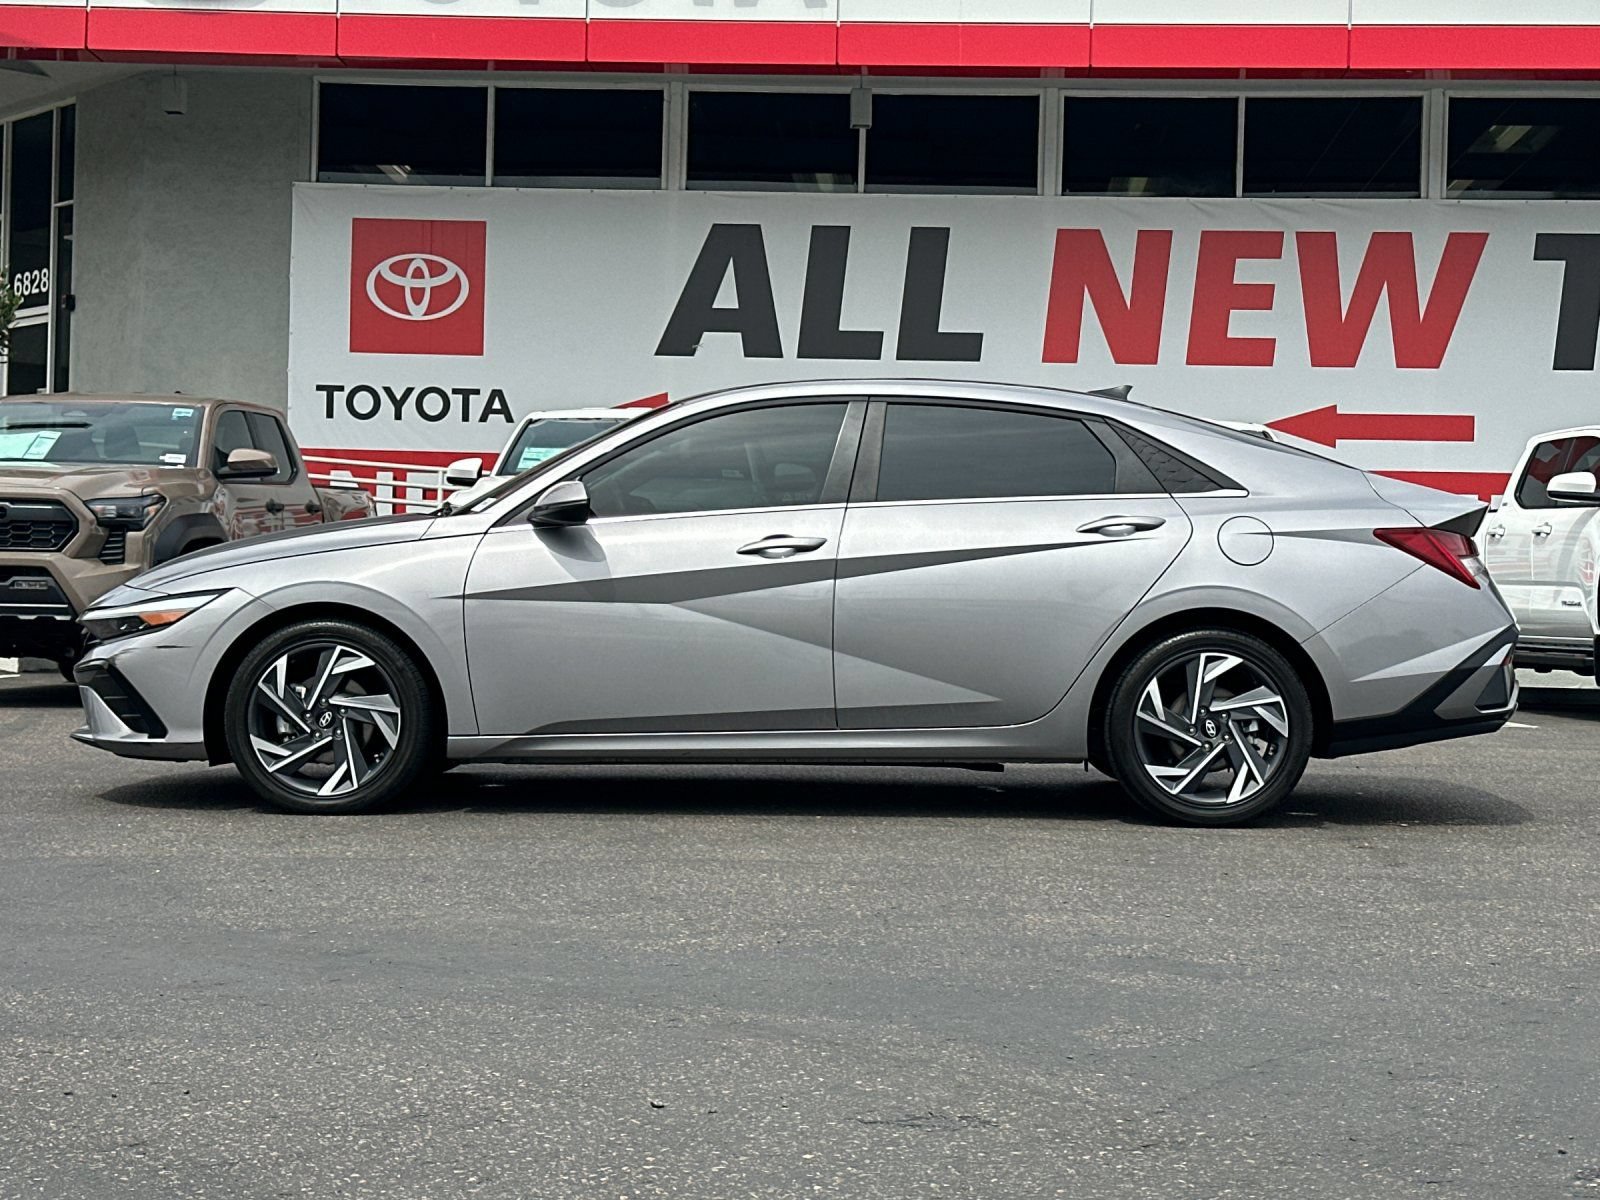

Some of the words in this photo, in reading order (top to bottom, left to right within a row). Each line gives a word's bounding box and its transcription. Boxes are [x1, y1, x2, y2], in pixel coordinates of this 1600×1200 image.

[13, 267, 49, 297] 6828
[655, 223, 983, 361] ALL
[1042, 229, 1489, 368] NEW
[315, 384, 515, 424] TOYOTA
